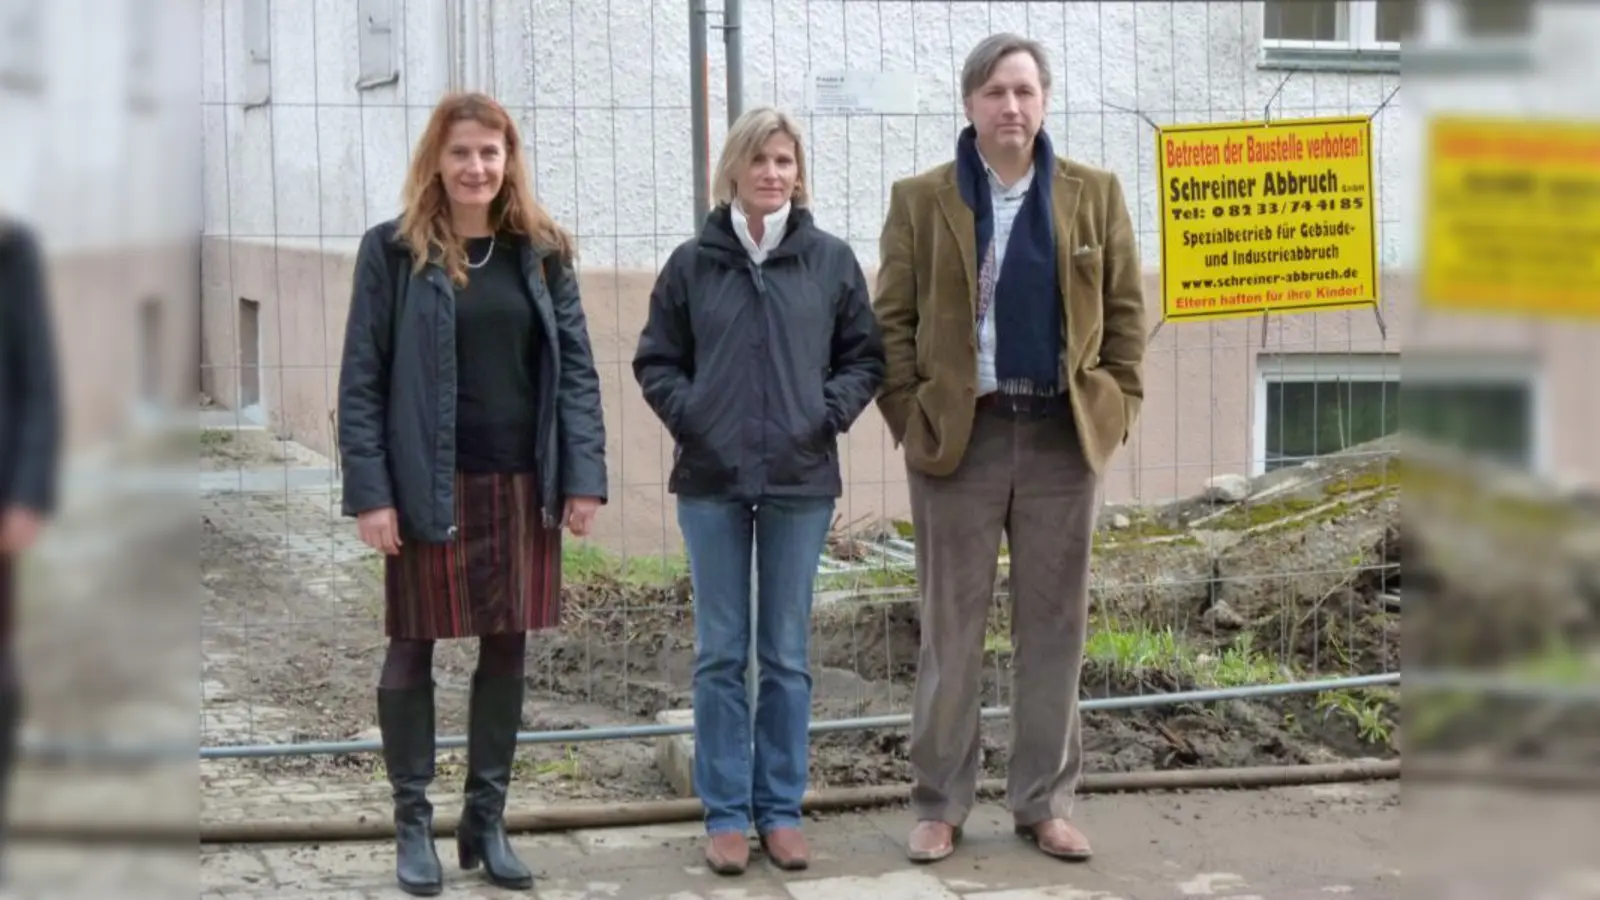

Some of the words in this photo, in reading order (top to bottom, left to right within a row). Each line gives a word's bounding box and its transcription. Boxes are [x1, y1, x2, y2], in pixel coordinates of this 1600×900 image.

[1166, 139, 1220, 168] Betreten
[1224, 137, 1243, 165] der
[1247, 133, 1303, 164] Baustelle
[1307, 130, 1364, 159] verboten!
[1170, 175, 1256, 202] Schreiner
[1264, 169, 1338, 197] Abbruch
[1172, 207, 1205, 221] Tel:
[1183, 226, 1272, 247] Spezialbetrieb
[1277, 224, 1295, 240] für
[1300, 221, 1355, 238] Gebäude-
[1205, 251, 1228, 267] und
[1233, 244, 1339, 265] Industrieabbruch
[1181, 268, 1358, 289] www.schreiner-abbruch.de
[1176, 296, 1216, 309] Eltern
[1220, 293, 1262, 305] haften
[1266, 291, 1282, 302] für
[1287, 289, 1311, 300] ihre
[1316, 285, 1364, 298] Kinder!
